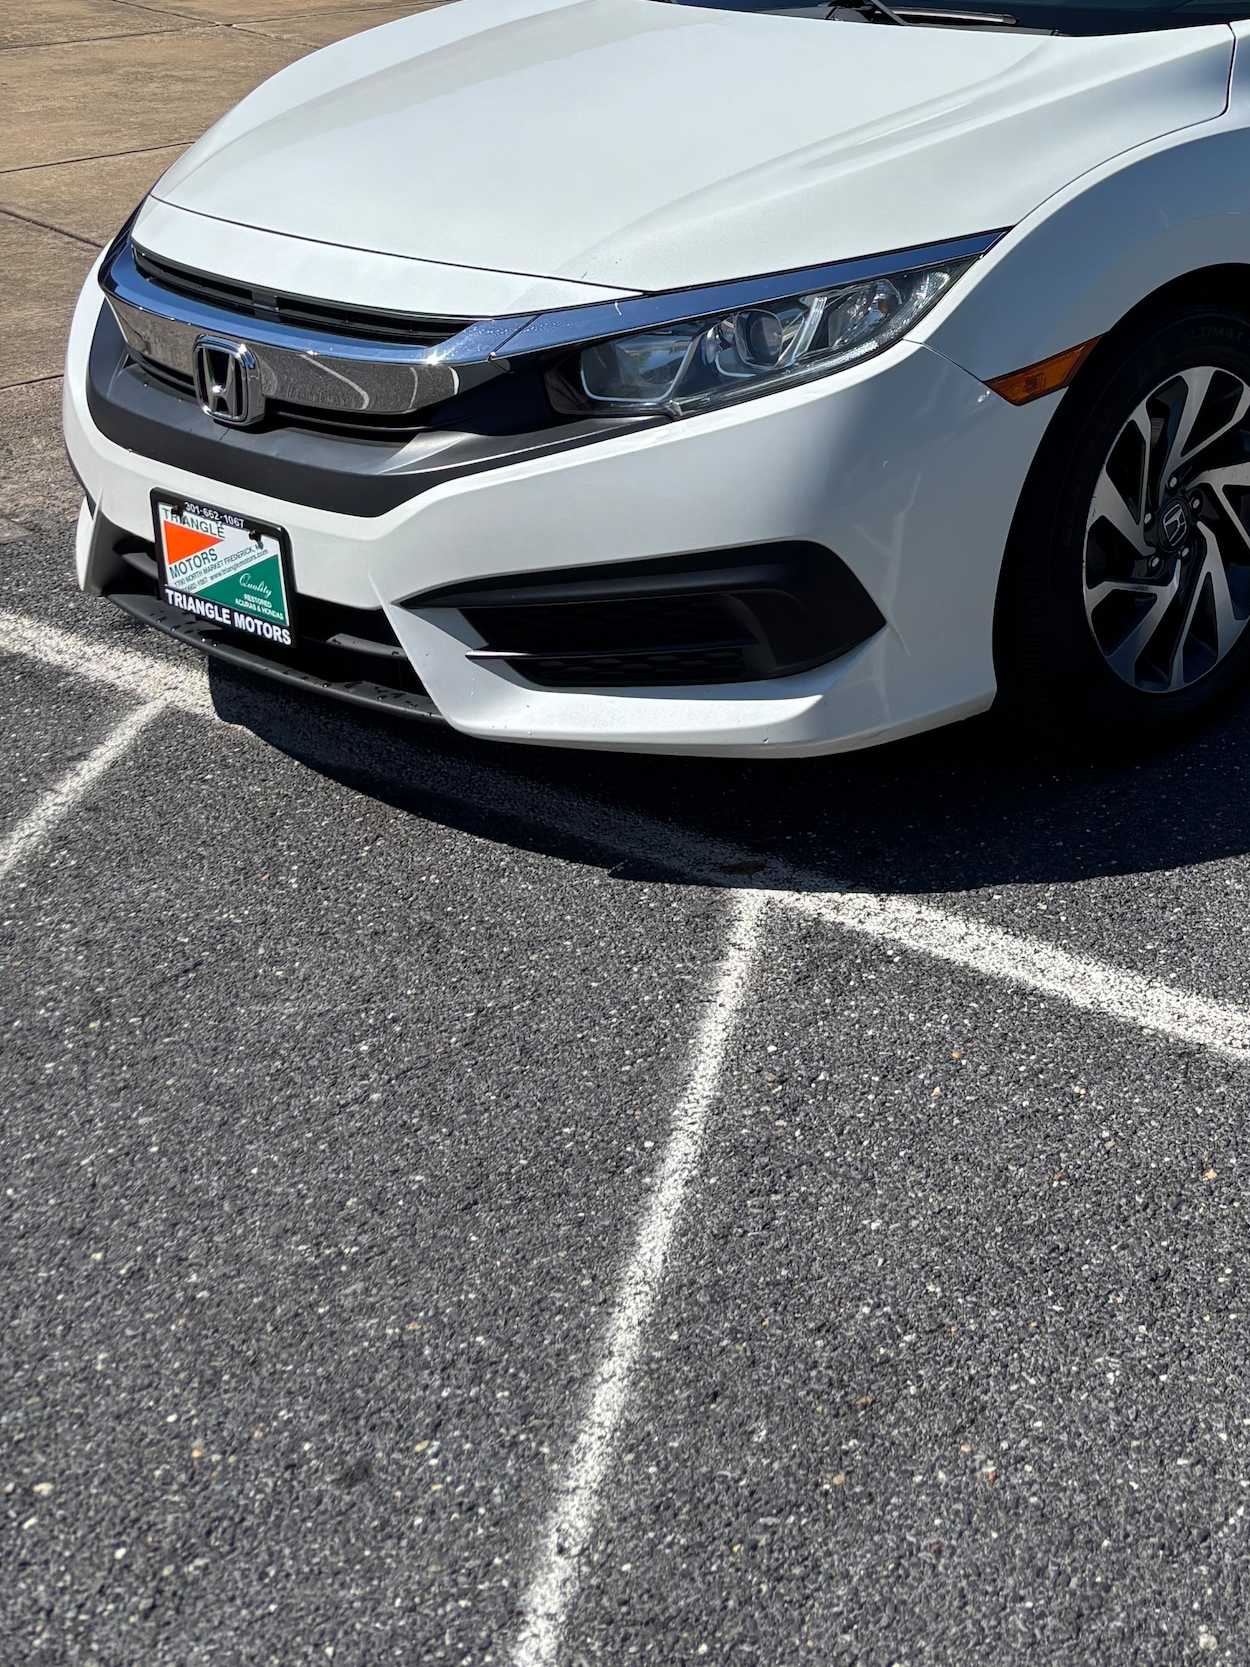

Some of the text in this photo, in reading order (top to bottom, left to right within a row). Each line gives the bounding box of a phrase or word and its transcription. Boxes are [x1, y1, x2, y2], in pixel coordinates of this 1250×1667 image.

[169, 548, 218, 579] MOTORS
[185, 570, 204, 583] NORTH
[203, 559, 224, 573] MARKET
[239, 572, 272, 599] Quality
[235, 598, 257, 611] ACURAS
[243, 593, 272, 609] RESTORED
[165, 588, 292, 646] TRIANGLE MOTORS
